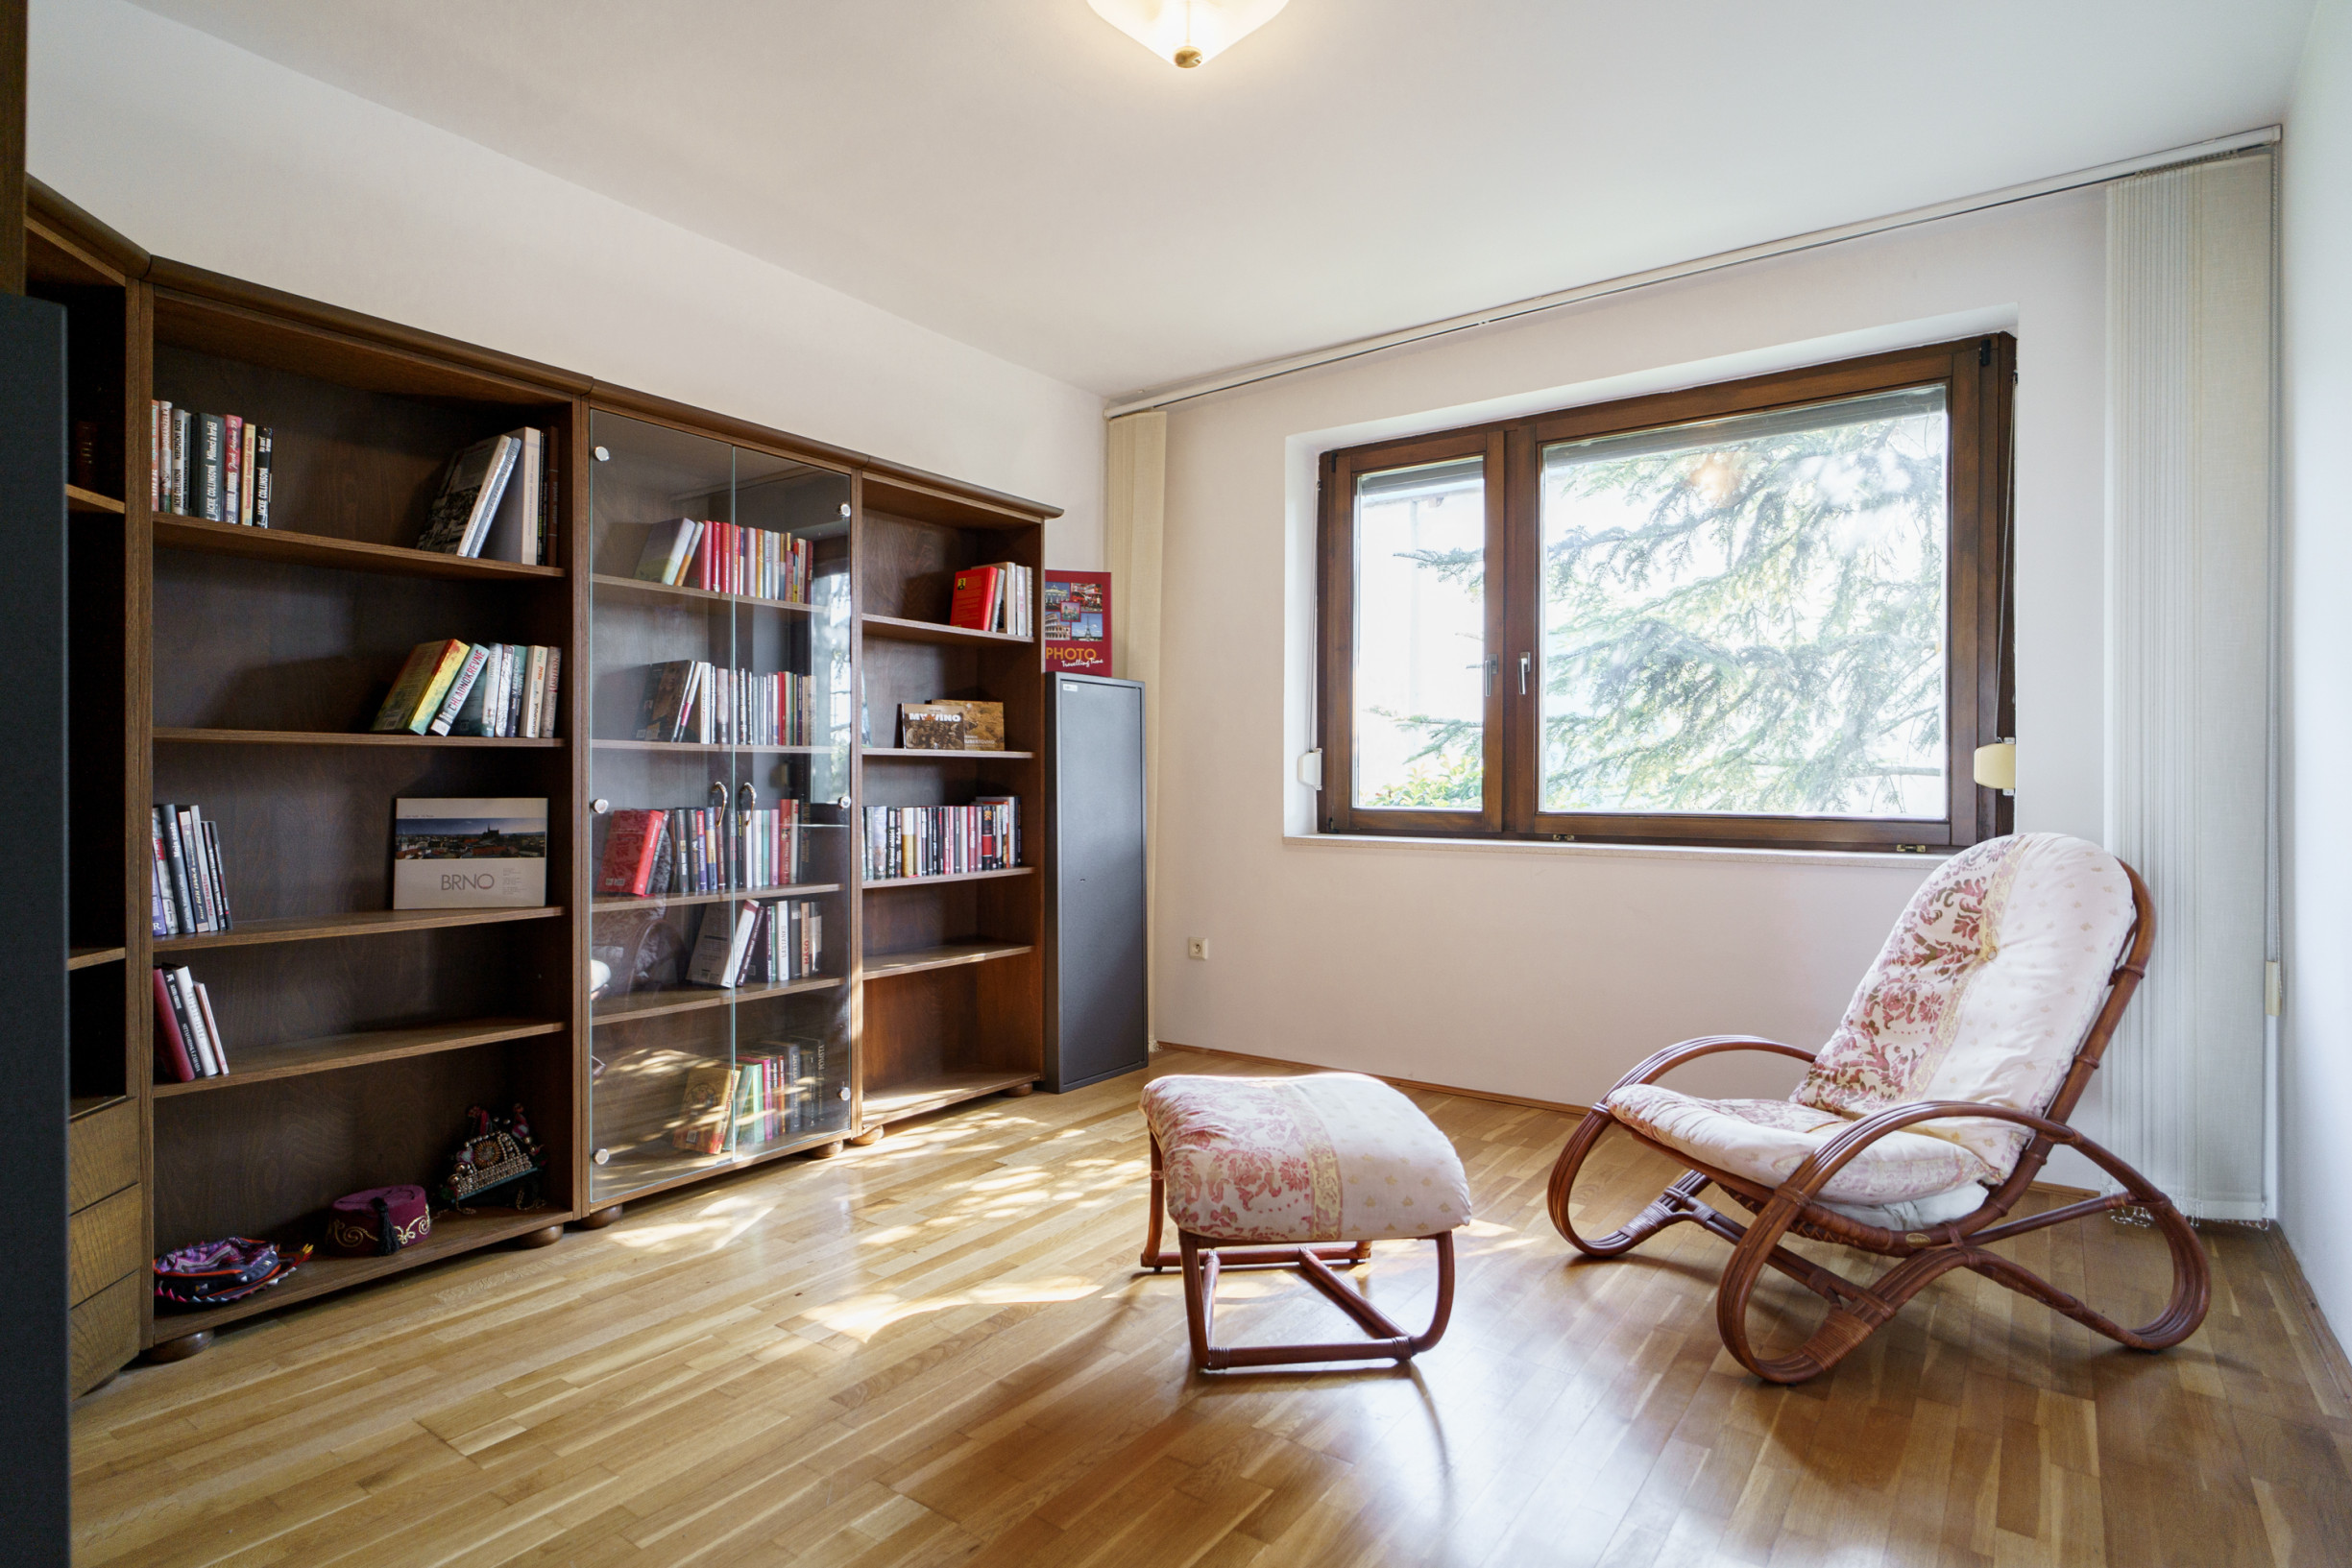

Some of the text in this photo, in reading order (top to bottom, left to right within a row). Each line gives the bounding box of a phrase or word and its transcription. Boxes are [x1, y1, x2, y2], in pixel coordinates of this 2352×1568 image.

[206, 442, 217, 461] Milenci
[206, 465, 217, 497] COLLINSOVÁ
[256, 467, 269, 516] JACKIE COLLINSOVÁ
[206, 497, 216, 515] JACKIE
[1045, 646, 1097, 661] PHOTO
[1061, 659, 1090, 668] Travelling
[172, 843, 181, 857] Moja
[441, 873, 495, 891] BRNO
